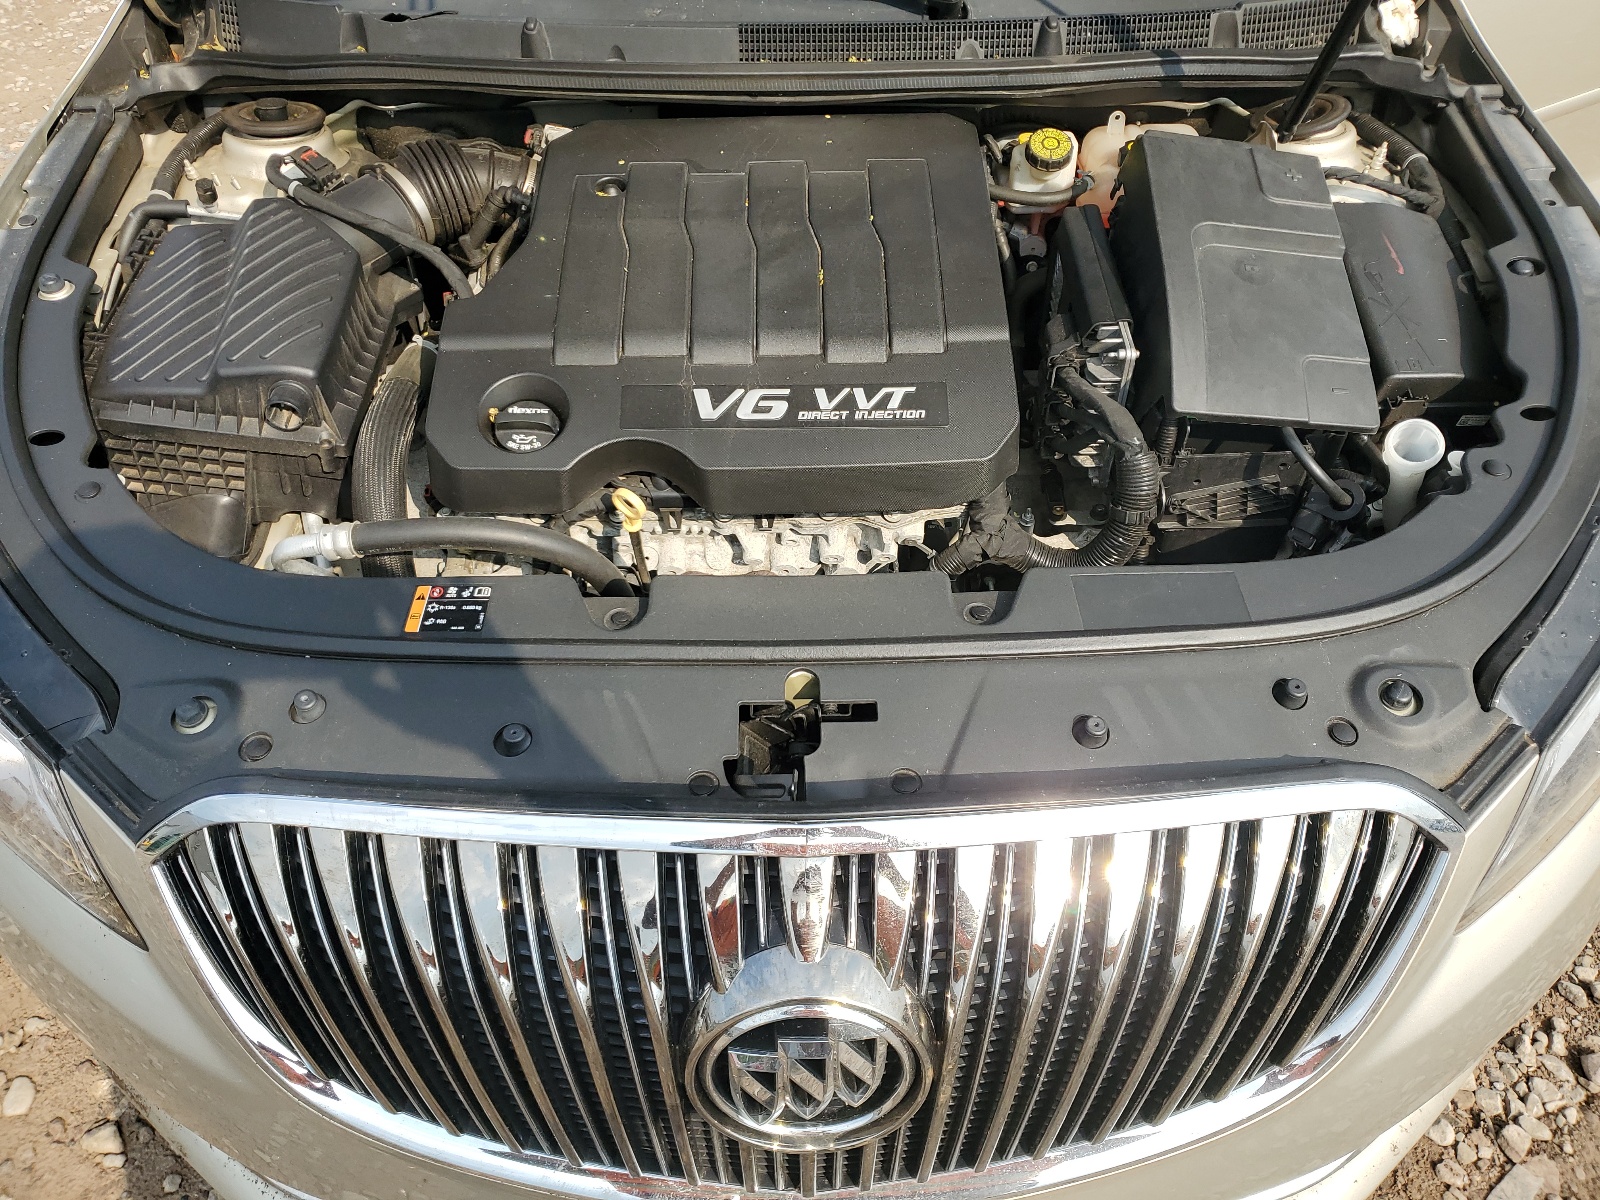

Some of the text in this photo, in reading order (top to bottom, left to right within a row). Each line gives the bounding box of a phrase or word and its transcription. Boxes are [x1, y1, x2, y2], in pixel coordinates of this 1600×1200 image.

[693, 387, 916, 420] V6 VVT
[798, 409, 926, 420] DIRECT INJECTION
